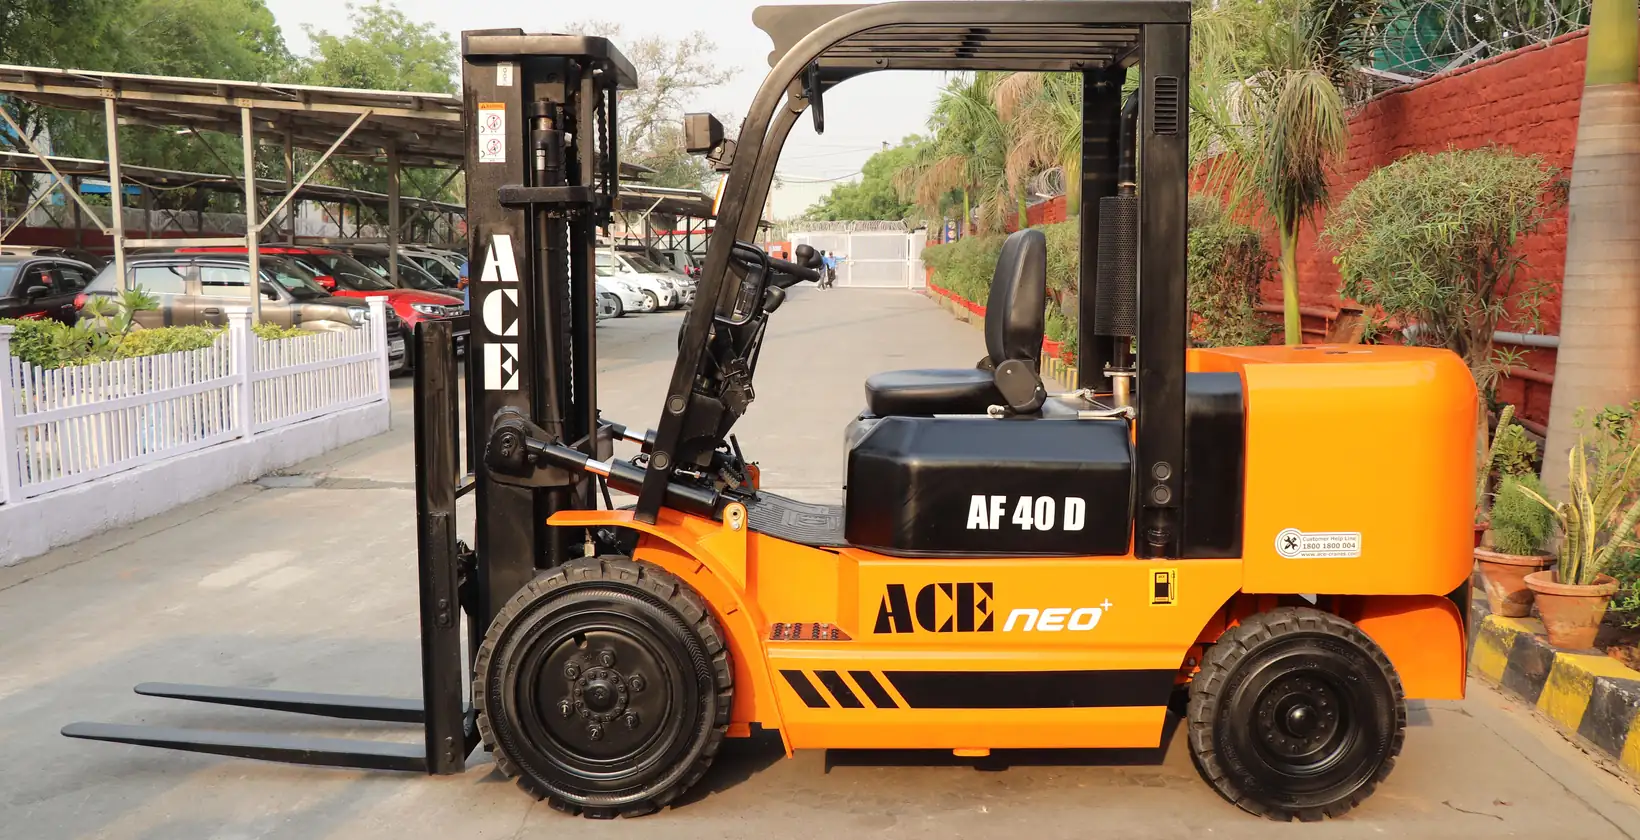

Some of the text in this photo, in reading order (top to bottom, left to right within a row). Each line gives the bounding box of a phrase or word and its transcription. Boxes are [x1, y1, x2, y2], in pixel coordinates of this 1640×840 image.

[481, 234, 519, 390] ACE
[966, 495, 1086, 531] AF 40 D
[873, 582, 994, 634] ACE
